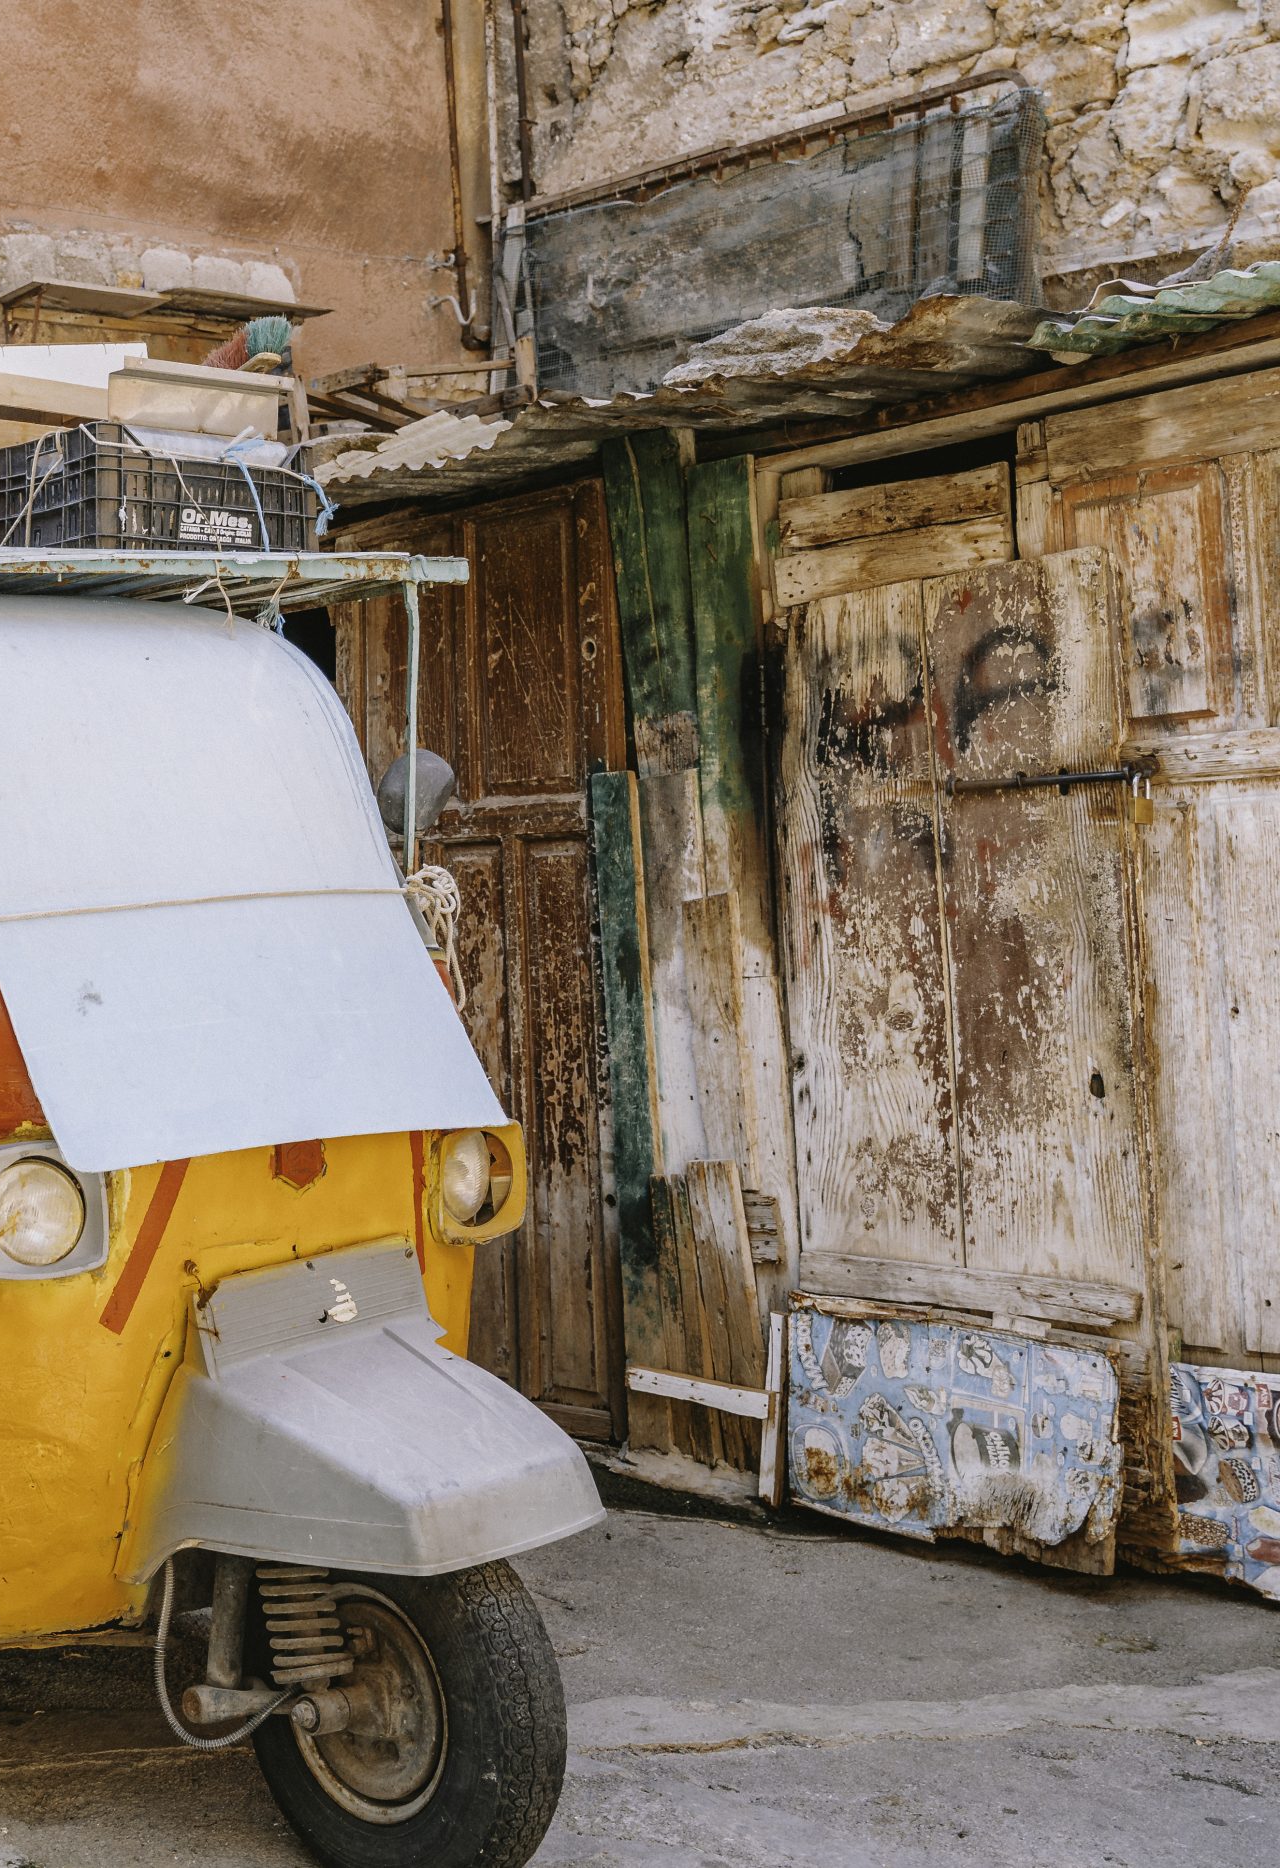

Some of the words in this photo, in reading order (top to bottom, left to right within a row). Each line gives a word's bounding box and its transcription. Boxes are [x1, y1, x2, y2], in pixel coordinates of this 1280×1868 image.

[179, 532, 209, 541] PRODOTTO:
[235, 537, 252, 545] ITALIA
[990, 1431, 1011, 1470] ONNO
